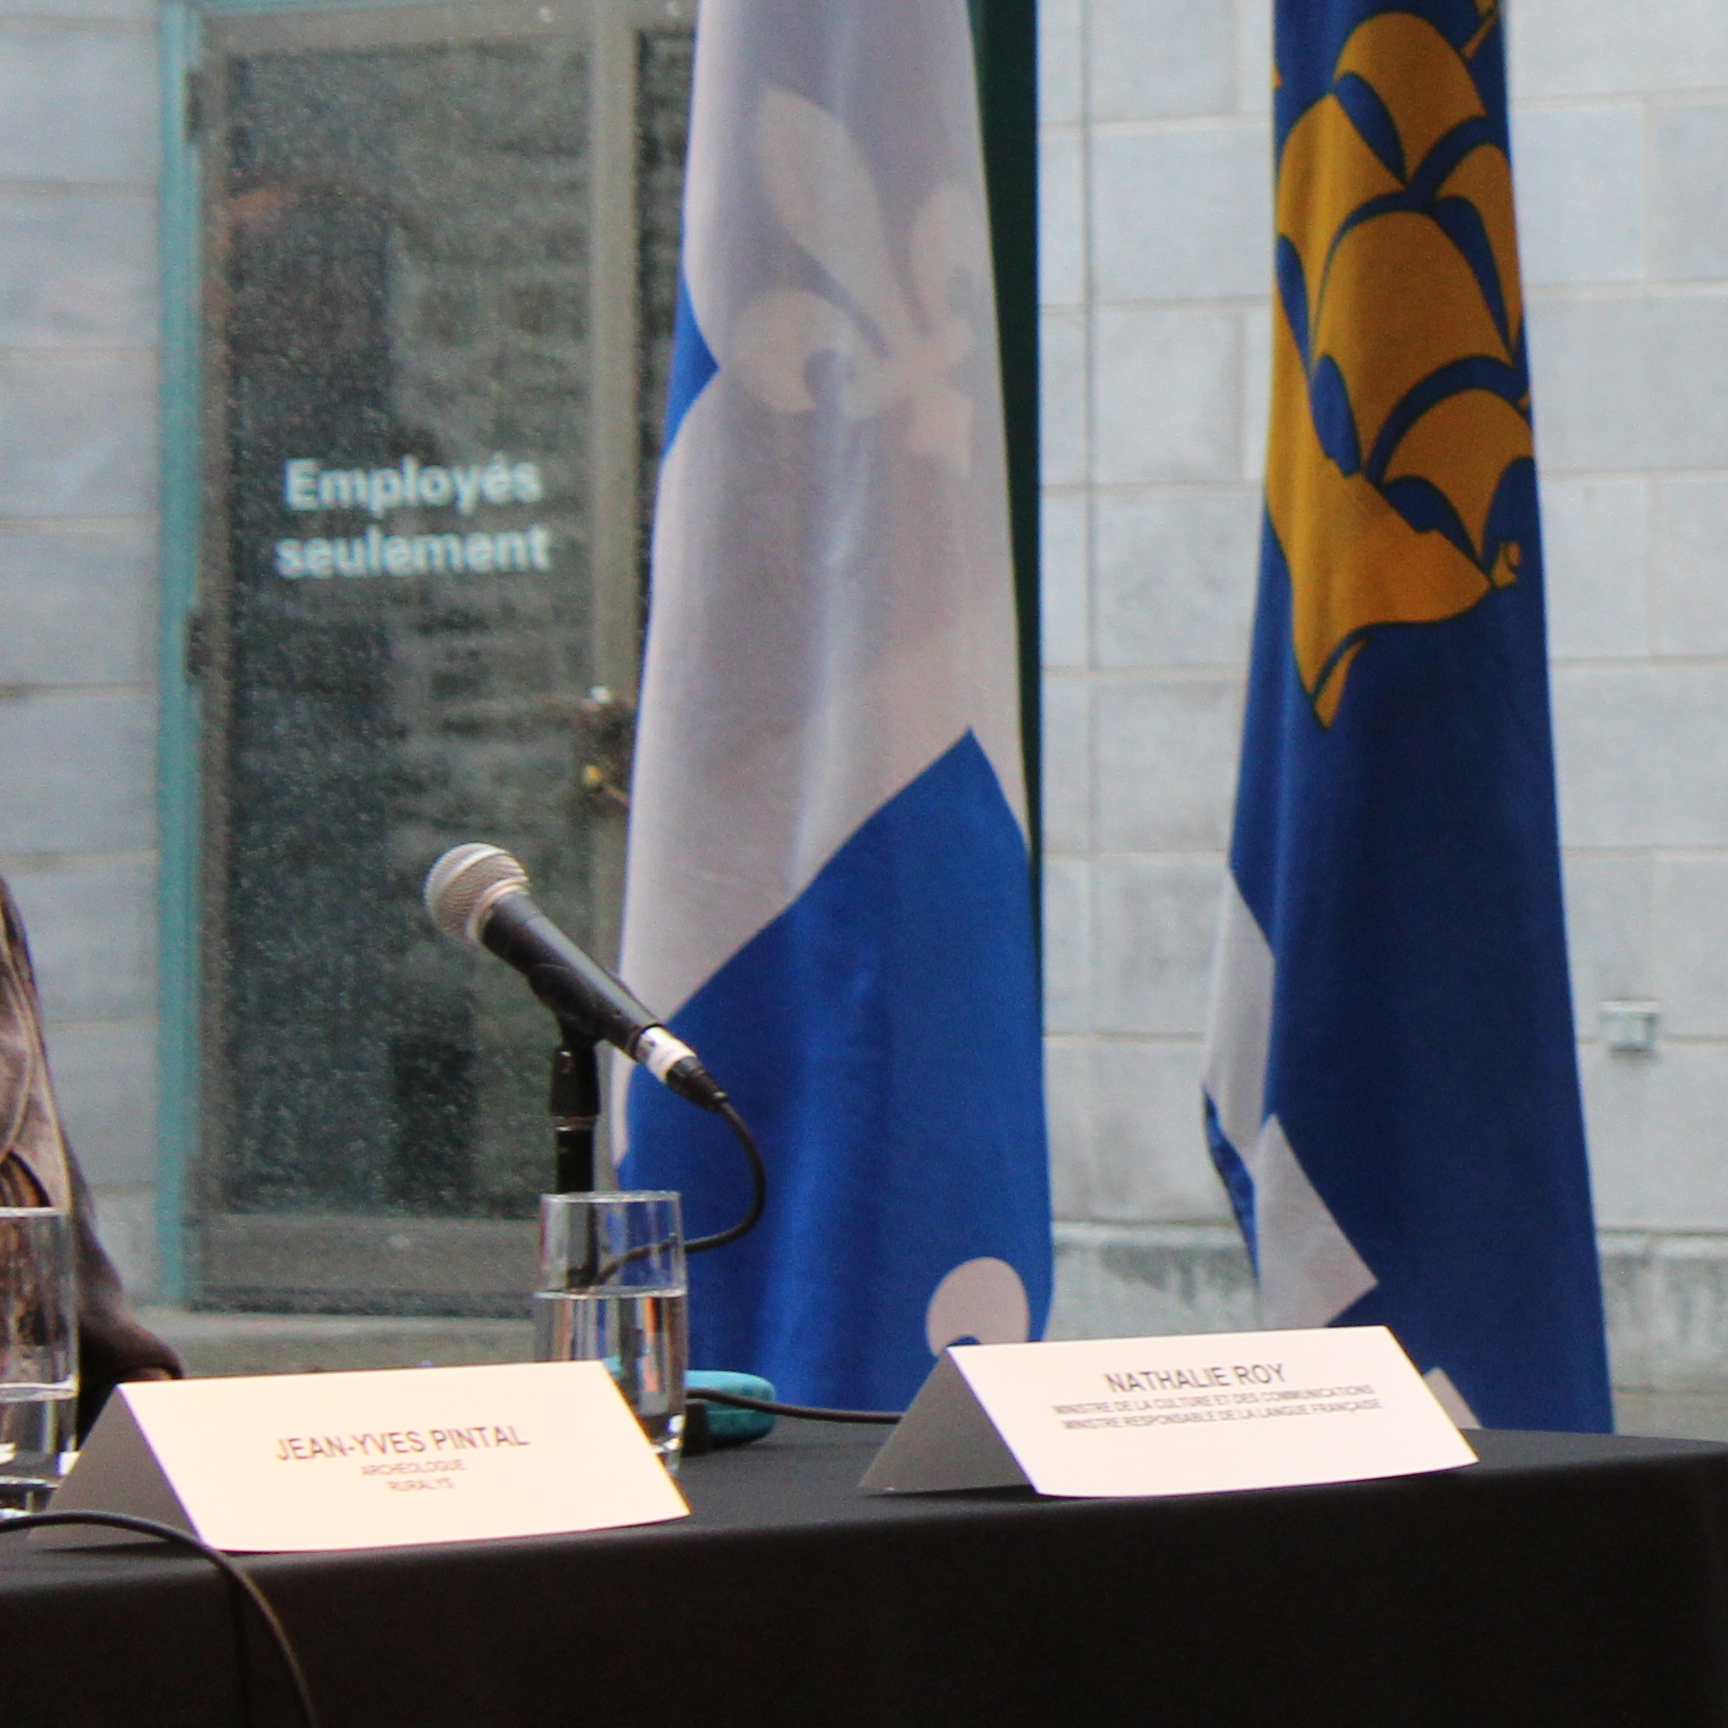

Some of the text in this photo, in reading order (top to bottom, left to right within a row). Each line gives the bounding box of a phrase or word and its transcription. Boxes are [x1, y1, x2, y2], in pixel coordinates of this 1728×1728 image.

[285, 451, 544, 519] Employés
[274, 524, 551, 579] seulement
[1104, 1363, 1286, 1392] NATHALIE ROY
[1052, 1401, 1114, 1415] MINISTRE
[1114, 1400, 1134, 1413] DE
[1135, 1399, 1151, 1411] LA
[1153, 1395, 1213, 1410] CULTURE
[1232, 1391, 1259, 1405] DES
[1260, 1383, 1375, 1402] COMMUNICATIONS
[1122, 1410, 1218, 1426] RESPONSABLE
[1218, 1409, 1239, 1421] DE
[1239, 1408, 1256, 1419] LA
[1257, 1404, 1311, 1418] LANGUE
[276, 1425, 531, 1461] JEAN-YVES PINTAL
